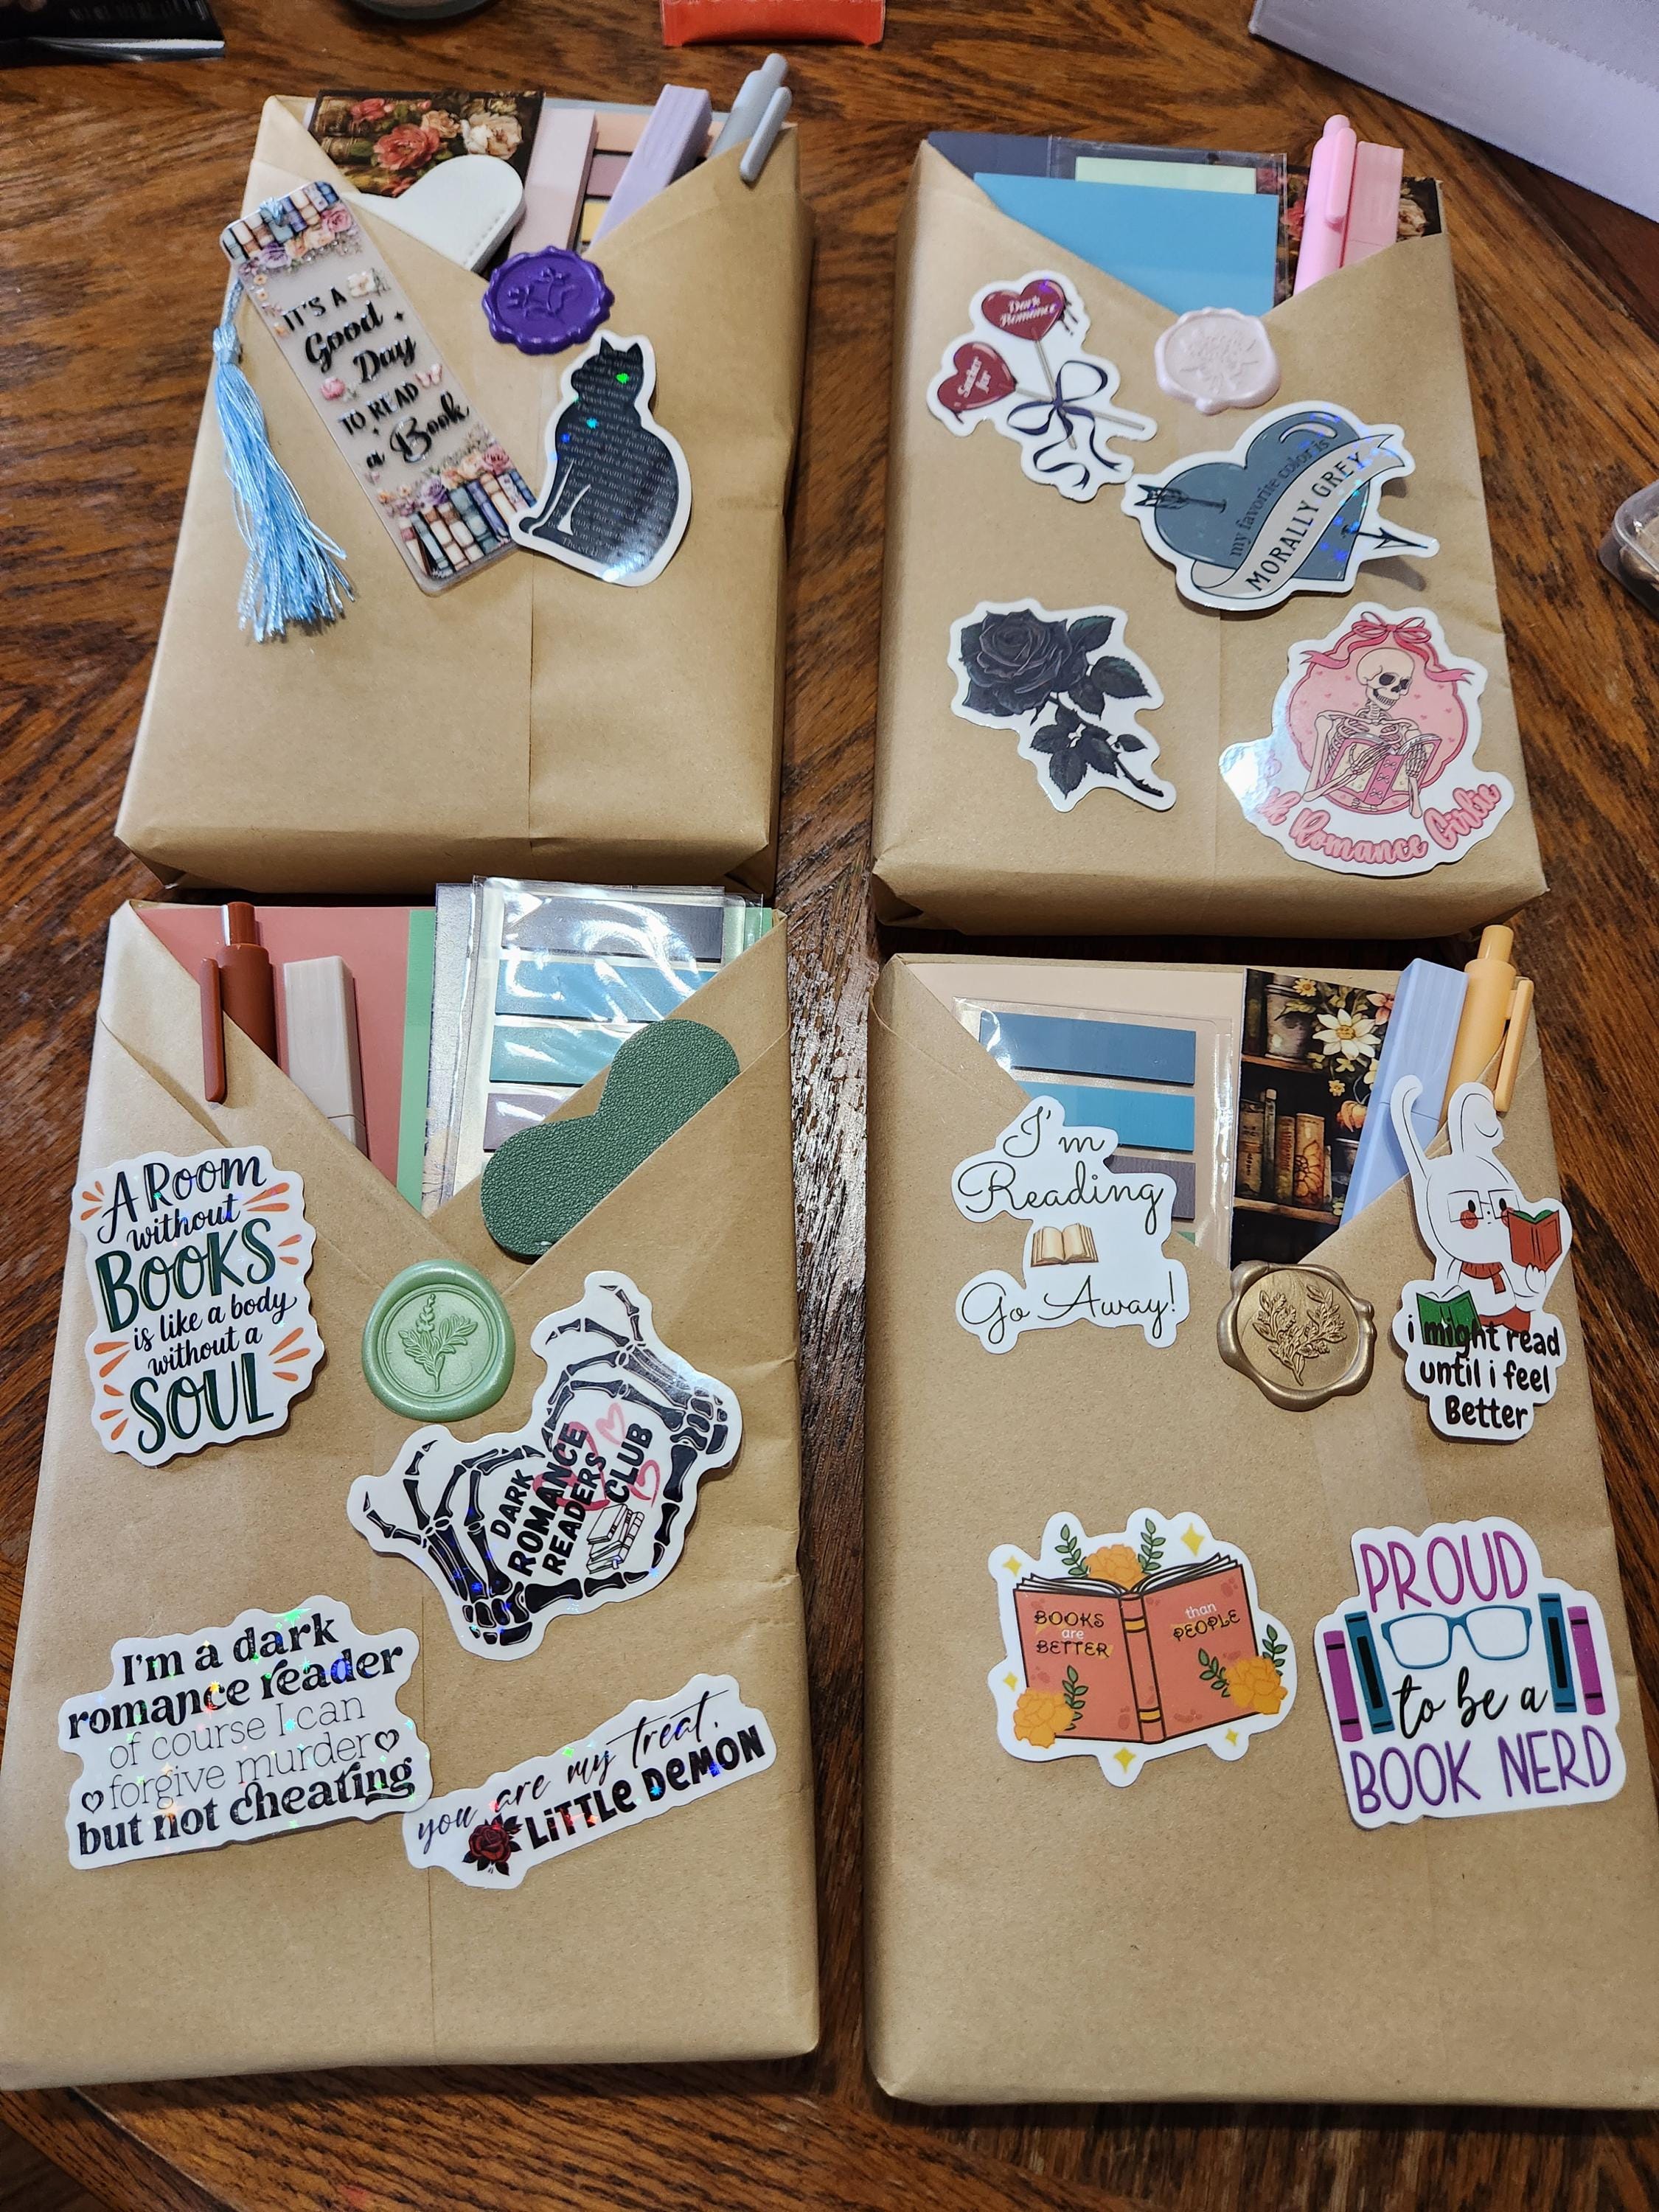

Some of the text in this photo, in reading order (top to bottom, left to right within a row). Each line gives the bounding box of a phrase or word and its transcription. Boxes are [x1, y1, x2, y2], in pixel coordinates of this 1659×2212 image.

[282, 287, 347, 331] IT'S A
[305, 300, 383, 373] Good
[1000, 304, 1057, 327] Romance
[1008, 295, 1040, 313] Dark
[352, 335, 417, 383] Day
[339, 383, 419, 436] TO READ
[366, 391, 470, 468] a Book
[1230, 439, 1329, 557] my favorite color is
[1245, 452, 1365, 591] MORALLY GREY
[1289, 784, 1502, 864] Romance Girlie
[1003, 1106, 1105, 1158] I'm
[97, 1172, 139, 1244] A
[127, 1194, 240, 1251] without
[958, 1161, 1164, 1235] Reading
[133, 1287, 297, 1352] is like a body
[961, 1270, 1175, 1345] Go Away!
[1408, 1314, 1560, 1358] i might read
[147, 1326, 263, 1377] without a
[1420, 1357, 1550, 1394] until i feel
[130, 1352, 274, 1453] SOUL
[1445, 1394, 1528, 1430] Better
[507, 1422, 588, 1577] ROMANCE
[605, 1423, 653, 1503] CLUB
[490, 1469, 534, 1540] DARK
[542, 1452, 607, 1576] READERS
[1360, 1530, 1528, 1613] PROUD
[1034, 1610, 1105, 1628] BOOKS
[1061, 1628, 1085, 1640] are
[1172, 1609, 1241, 1641] PEOPLE
[1185, 1601, 1217, 1619] than
[122, 1613, 339, 1686] I'm a dark
[1036, 1639, 1110, 1658] BETTER
[69, 1646, 403, 1739] romance reader
[1392, 1665, 1548, 1739] to be a
[109, 1696, 366, 1770] of course I can
[1350, 1725, 1612, 1814] BOOK NERD
[77, 1756, 415, 1856] but not cheating
[109, 1731, 371, 1810] forgive murder
[418, 1806, 478, 1854] you
[495, 1774, 552, 1814] are
[567, 1749, 616, 1784] my
